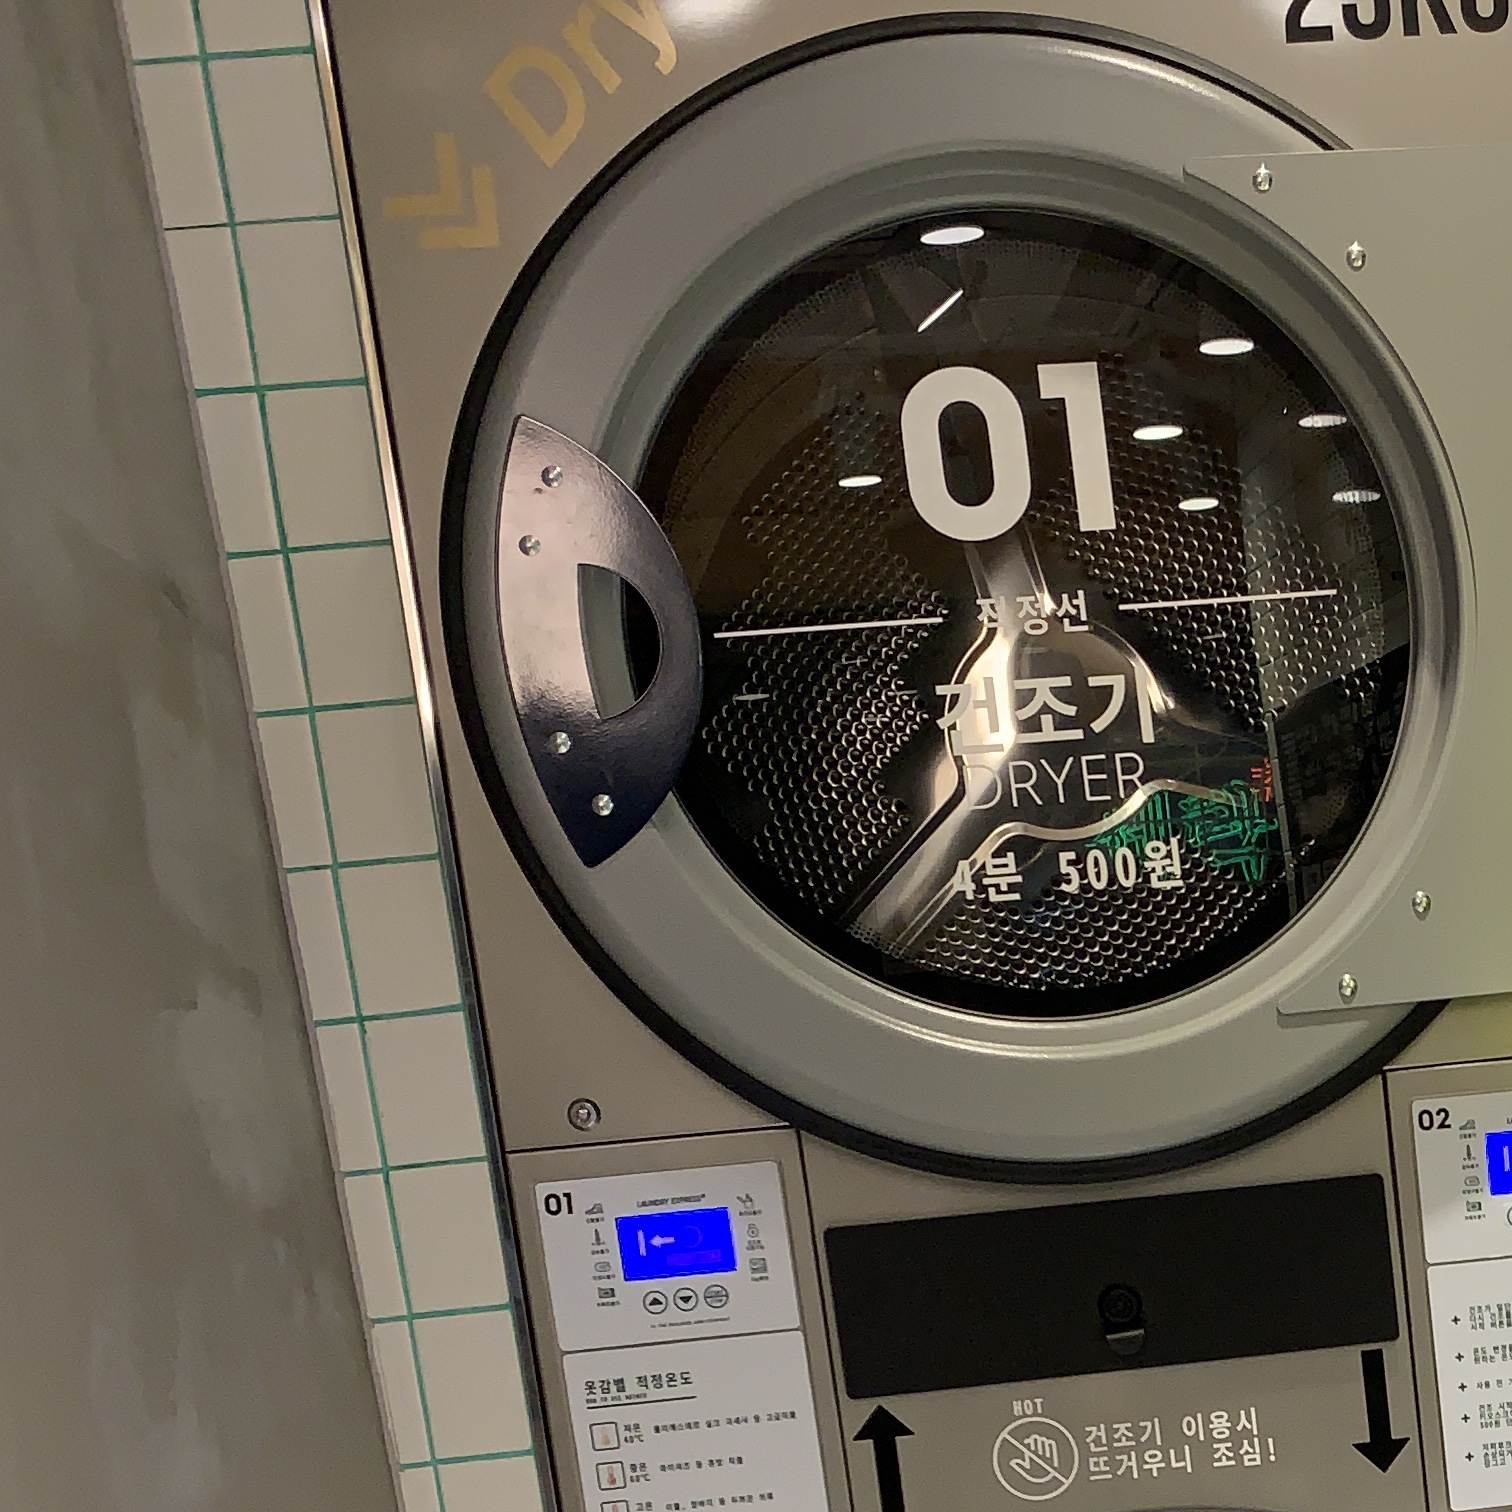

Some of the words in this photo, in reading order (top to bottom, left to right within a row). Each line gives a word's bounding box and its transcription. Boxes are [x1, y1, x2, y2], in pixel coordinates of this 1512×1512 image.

[484, 0, 677, 169] Dry
[901, 361, 1116, 541] 01
[976, 589, 1089, 635] 적정선
[935, 672, 1155, 756] 건조기
[962, 752, 1145, 810] DRYER
[953, 851, 1023, 901] 4분
[1059, 838, 1184, 893] 500원
[1417, 1106, 1452, 1131] 02
[542, 1191, 575, 1216] 01
[583, 1376, 626, 1396] 옷감별
[635, 1369, 693, 1391] 적정온도
[1013, 1399, 1043, 1415] HOT
[1085, 1418, 1162, 1451] 건조기
[1182, 1407, 1258, 1441] 이용시
[1089, 1446, 1192, 1480] 뜨거우니
[1212, 1438, 1276, 1467] 조심!
